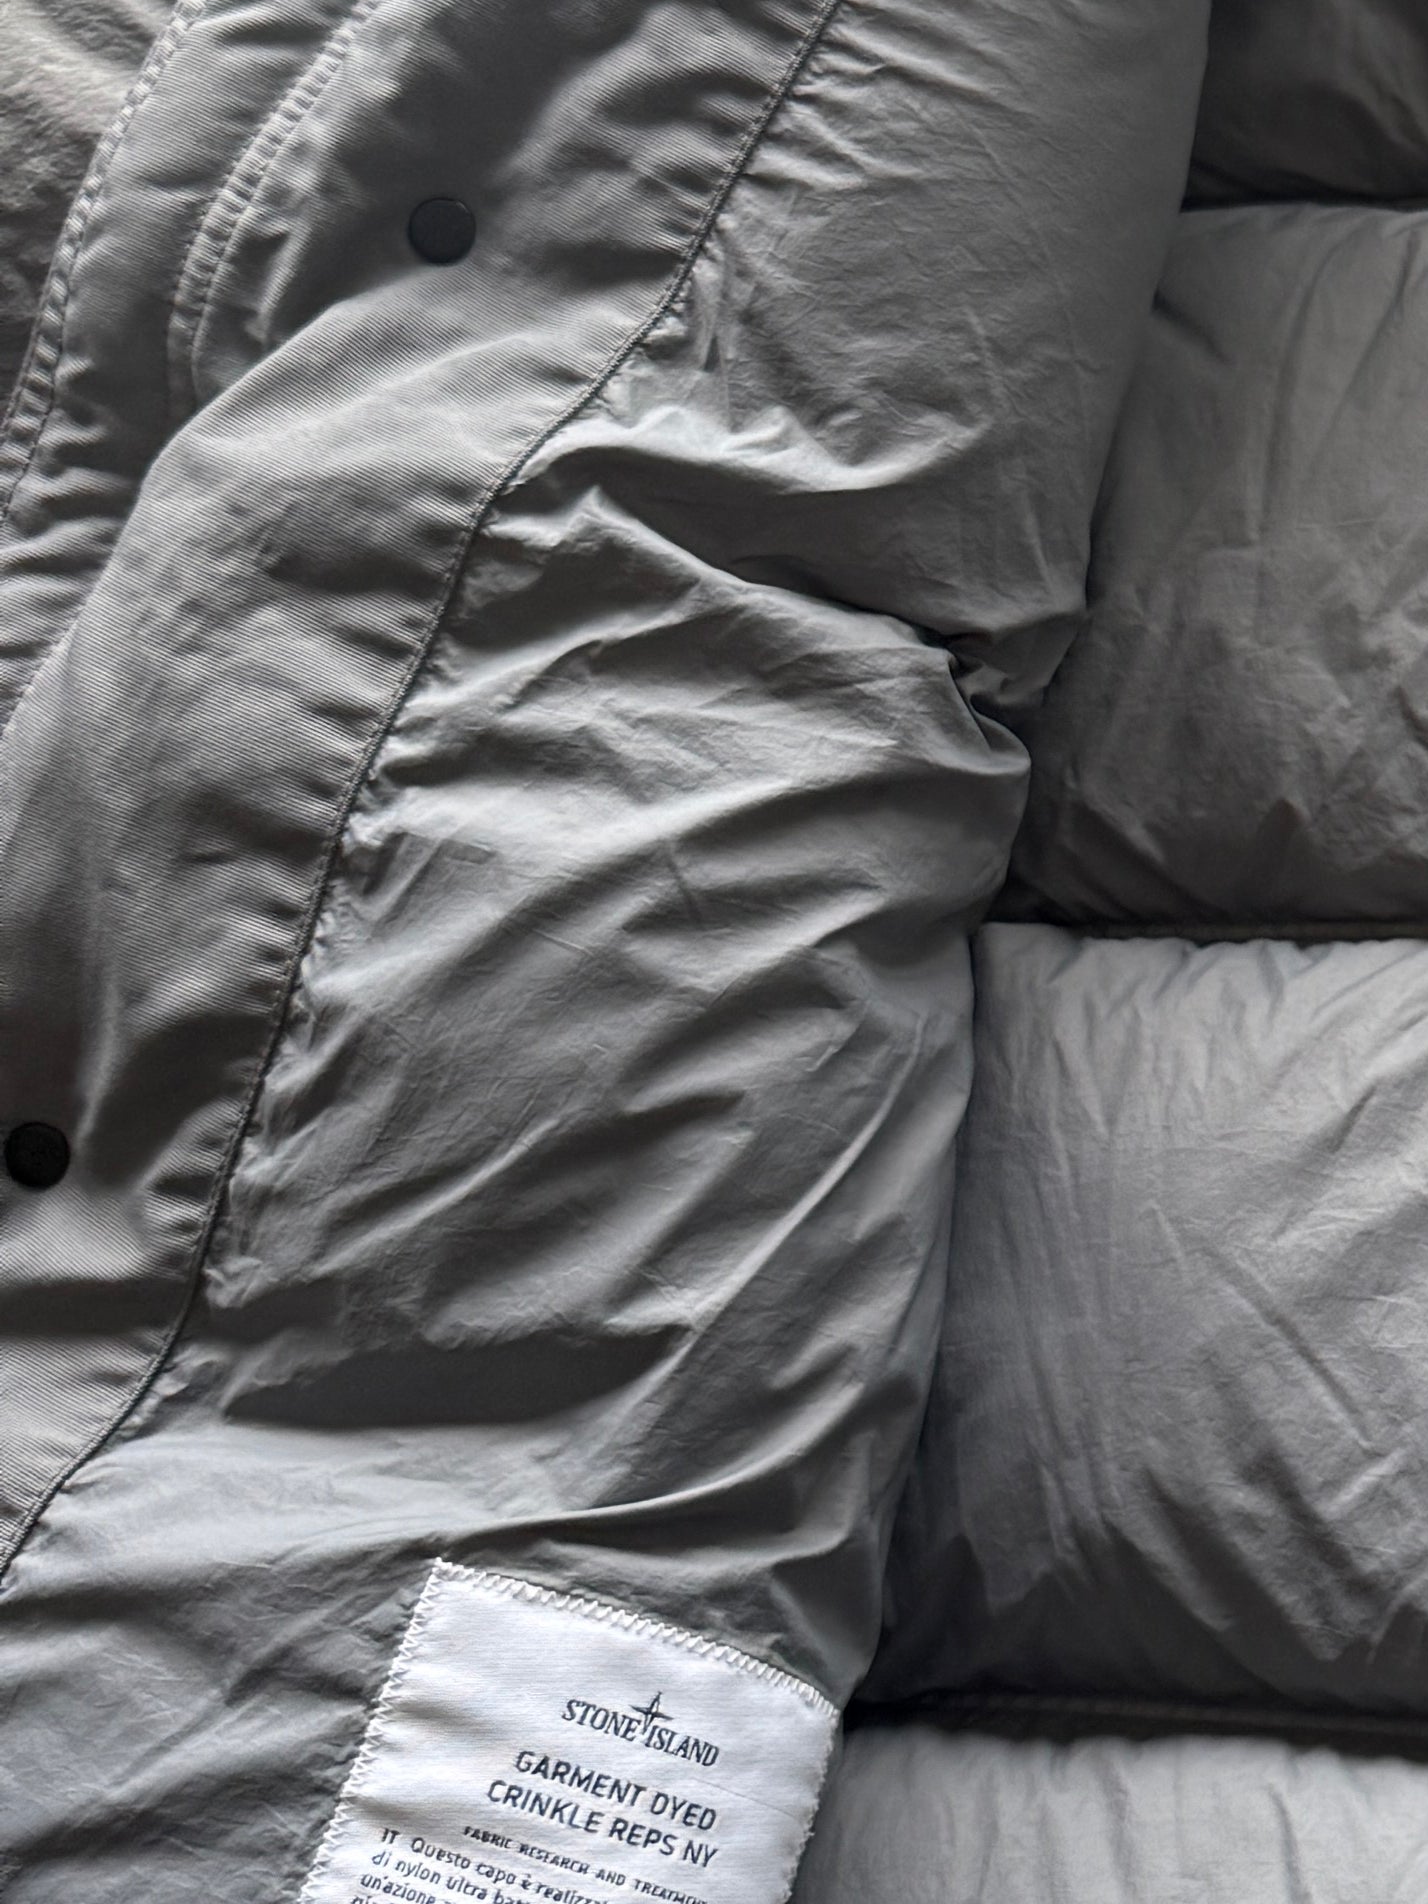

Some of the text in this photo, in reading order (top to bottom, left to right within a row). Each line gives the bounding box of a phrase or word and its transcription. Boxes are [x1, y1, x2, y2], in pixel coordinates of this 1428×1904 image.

[561, 1699, 720, 1767] STONE ISLAND
[514, 1750, 717, 1831] GARMENT DYED
[486, 1779, 719, 1868] CRINKLE REPS NY
[371, 1851, 389, 1867] di
[395, 1861, 441, 1884] nylon
[446, 1876, 487, 1900] ultra
[381, 1827, 401, 1844] IT
[410, 1837, 471, 1869] Questo
[475, 1863, 517, 1885] capo
[462, 1826, 513, 1849] FABRIC
[518, 1843, 590, 1875] RESEARCH
[595, 1869, 626, 1886] AND
